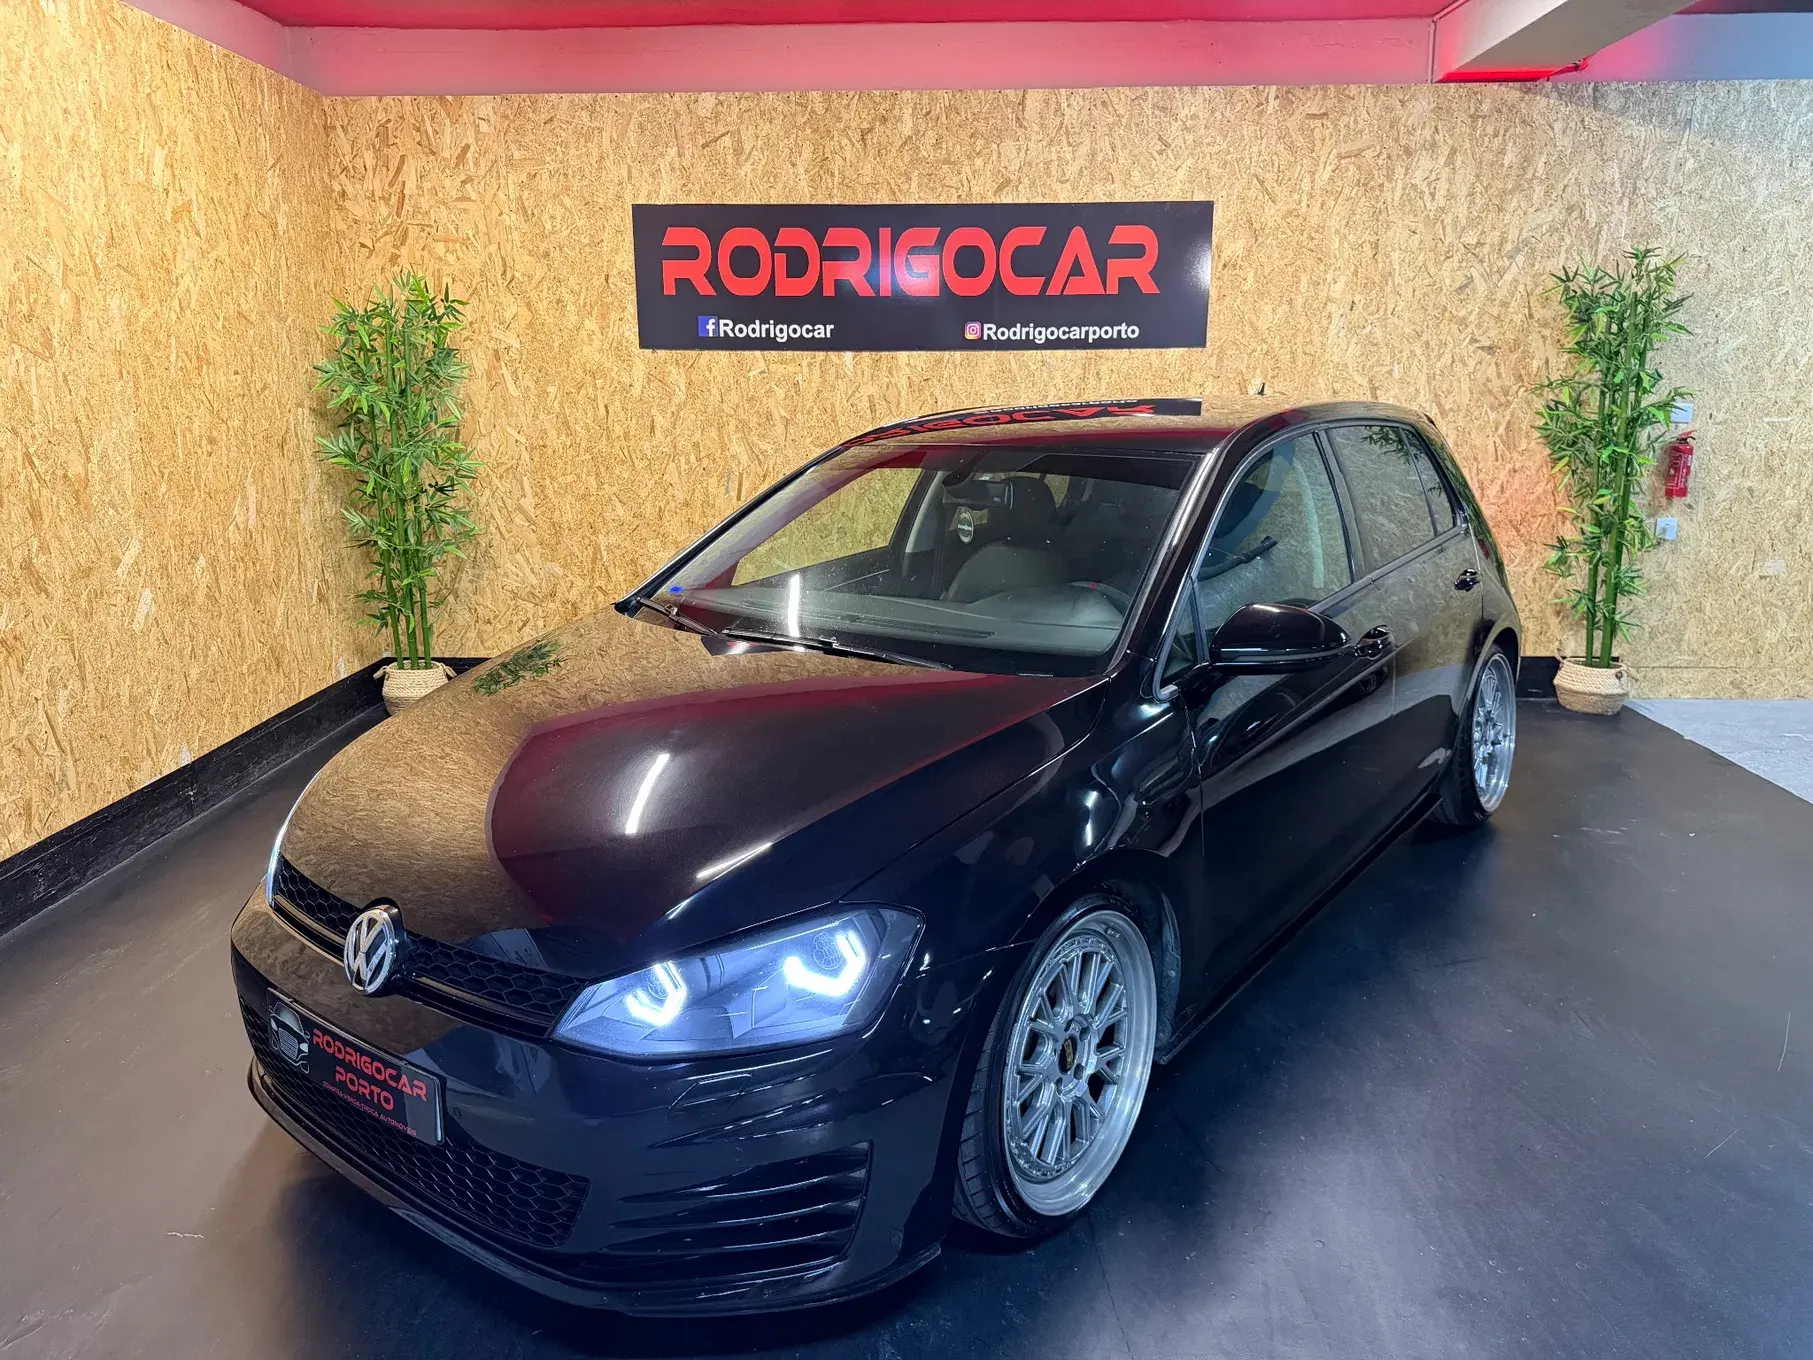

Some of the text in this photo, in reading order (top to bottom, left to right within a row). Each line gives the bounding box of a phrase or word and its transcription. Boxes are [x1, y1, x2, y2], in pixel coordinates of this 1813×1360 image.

[662, 225, 1160, 297] RODRIGOCAR
[718, 318, 835, 343] Rodrigocar
[983, 322, 1140, 344] Rodrigocarporto
[312, 1028, 427, 1101] RODRIGOCAR
[335, 1065, 394, 1111] PORTO
